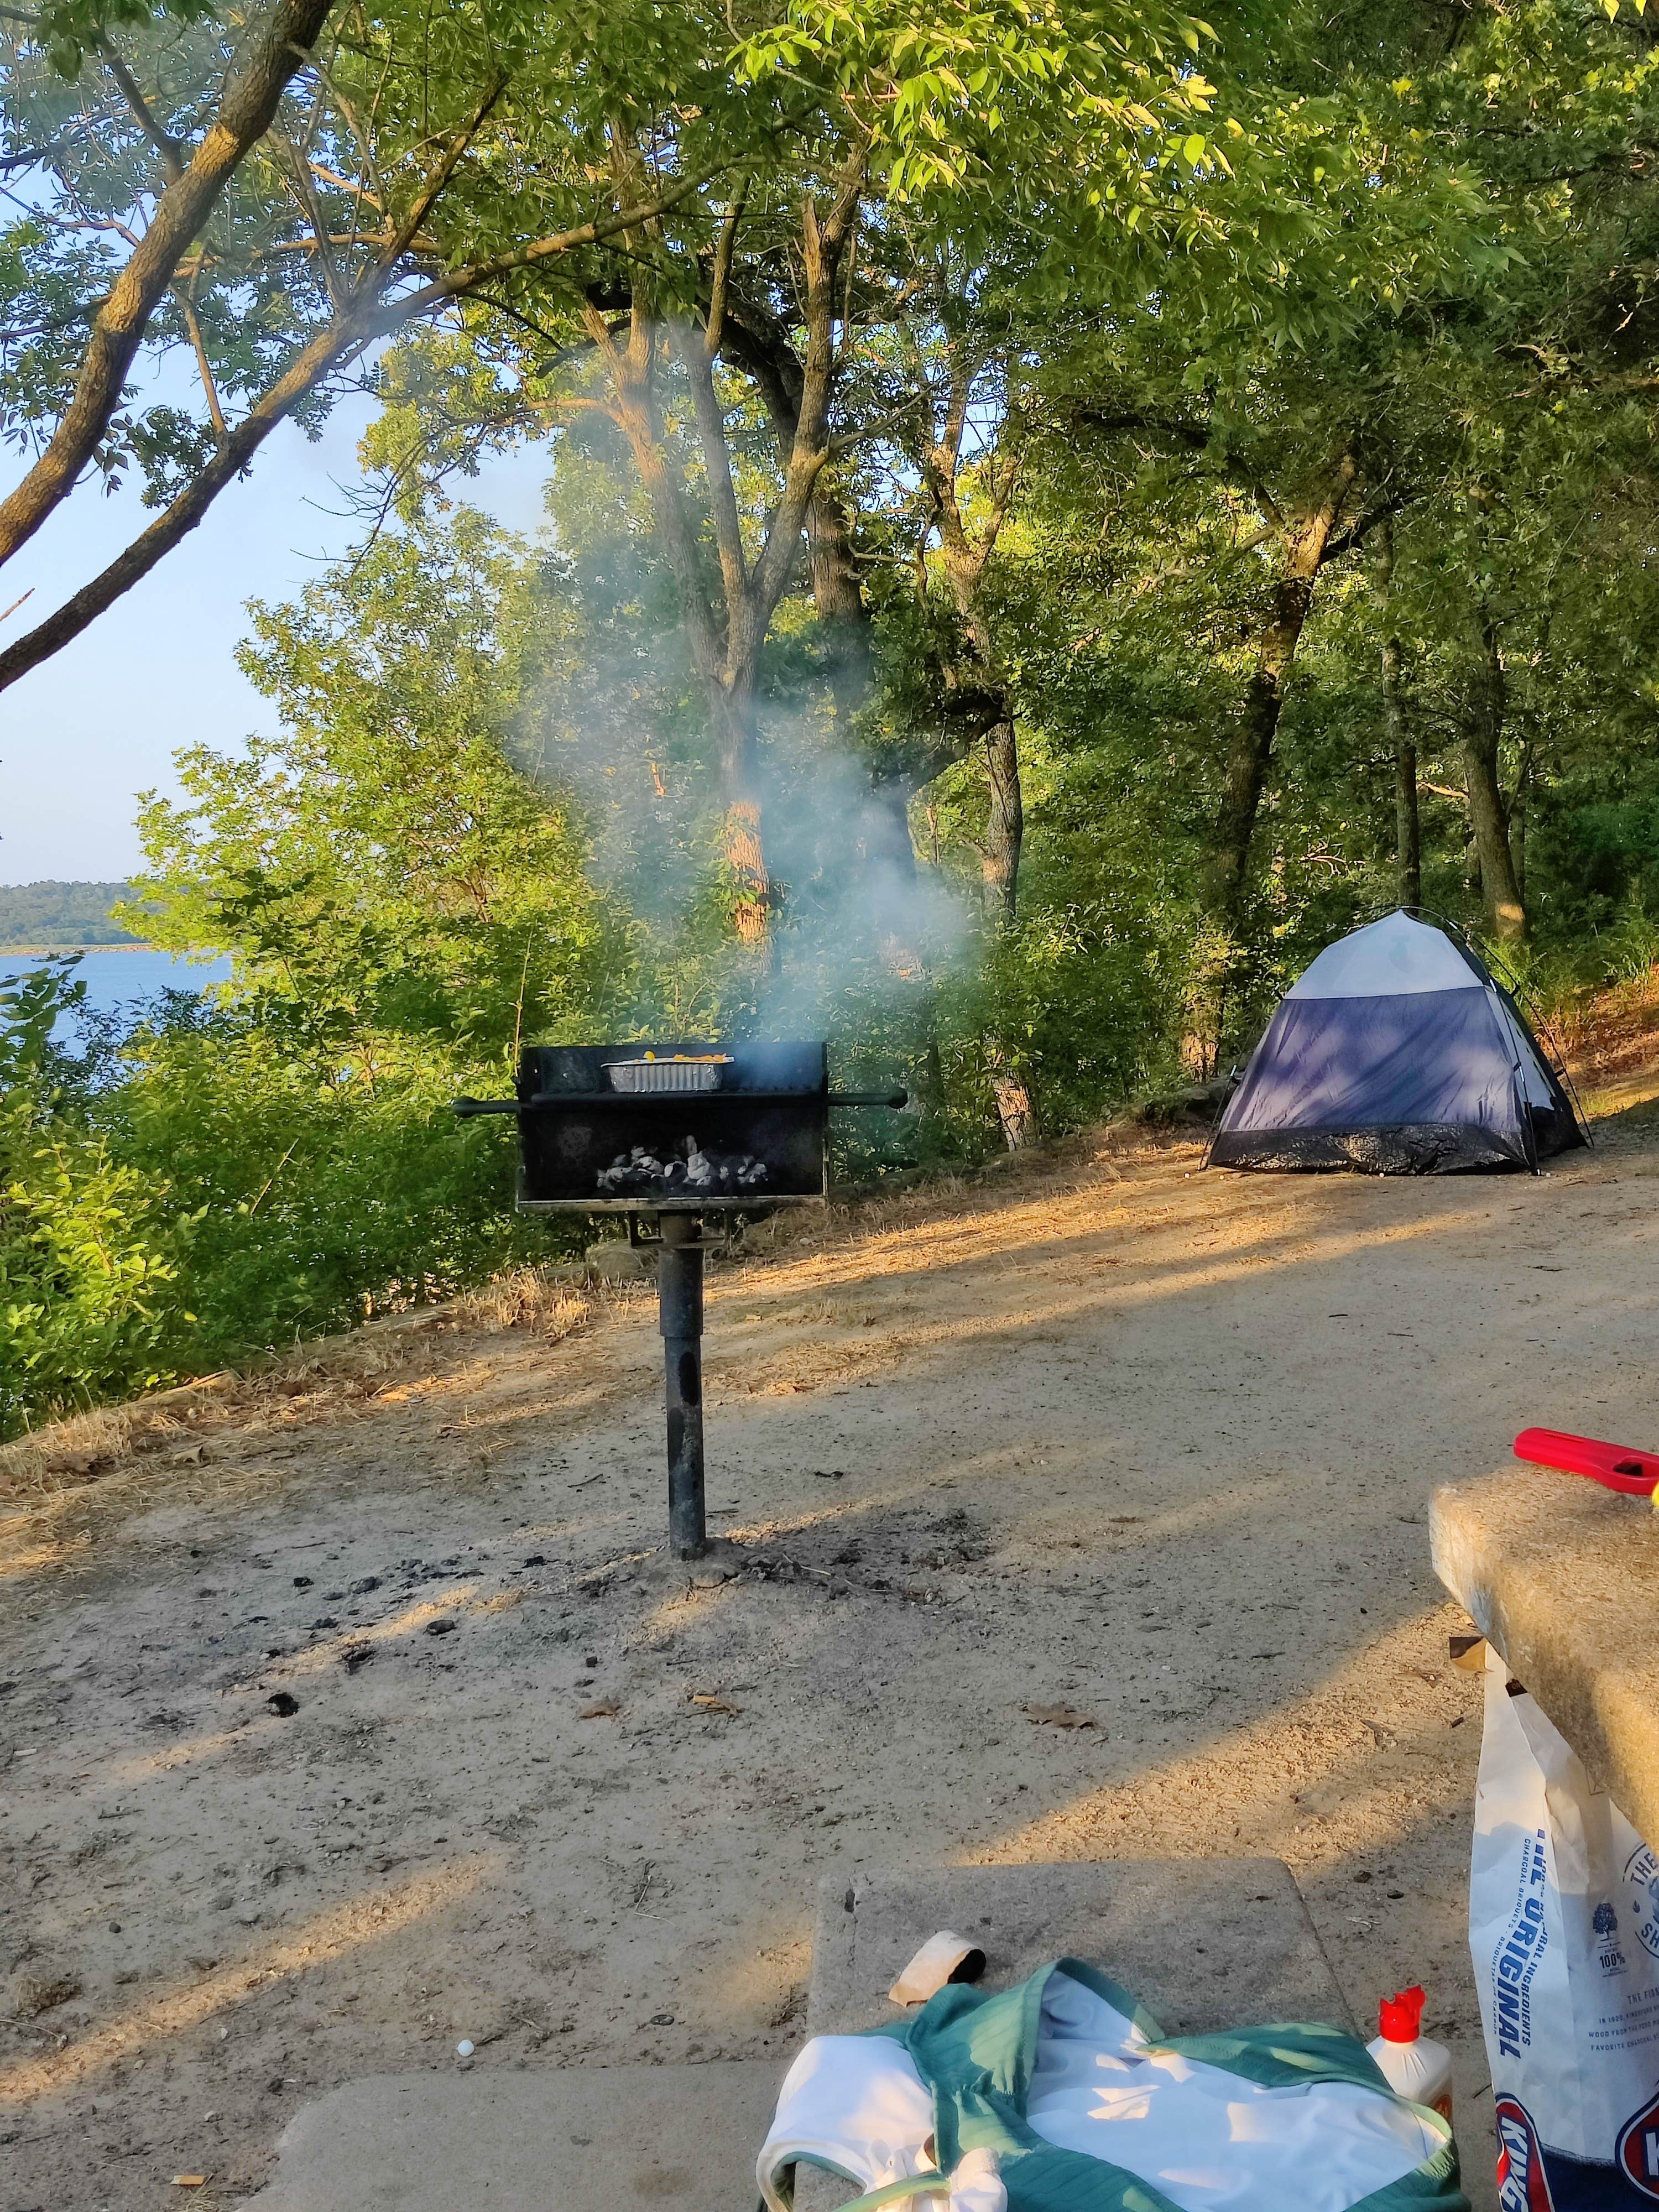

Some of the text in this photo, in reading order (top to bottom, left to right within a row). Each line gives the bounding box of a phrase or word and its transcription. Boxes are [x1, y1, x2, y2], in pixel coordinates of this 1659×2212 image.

[1519, 1838, 1531, 1884] CHARCOAL
[1630, 1853, 1658, 1885] THE
[1507, 1887, 1525, 1928] BRIQUETS
[1498, 1897, 1542, 2059] ORIGINAL
[1600, 1951, 1626, 1969] 100%
[1521, 1962, 1537, 2046] INGREDIENTS
[1627, 1986, 1659, 2005] THE FIRS
